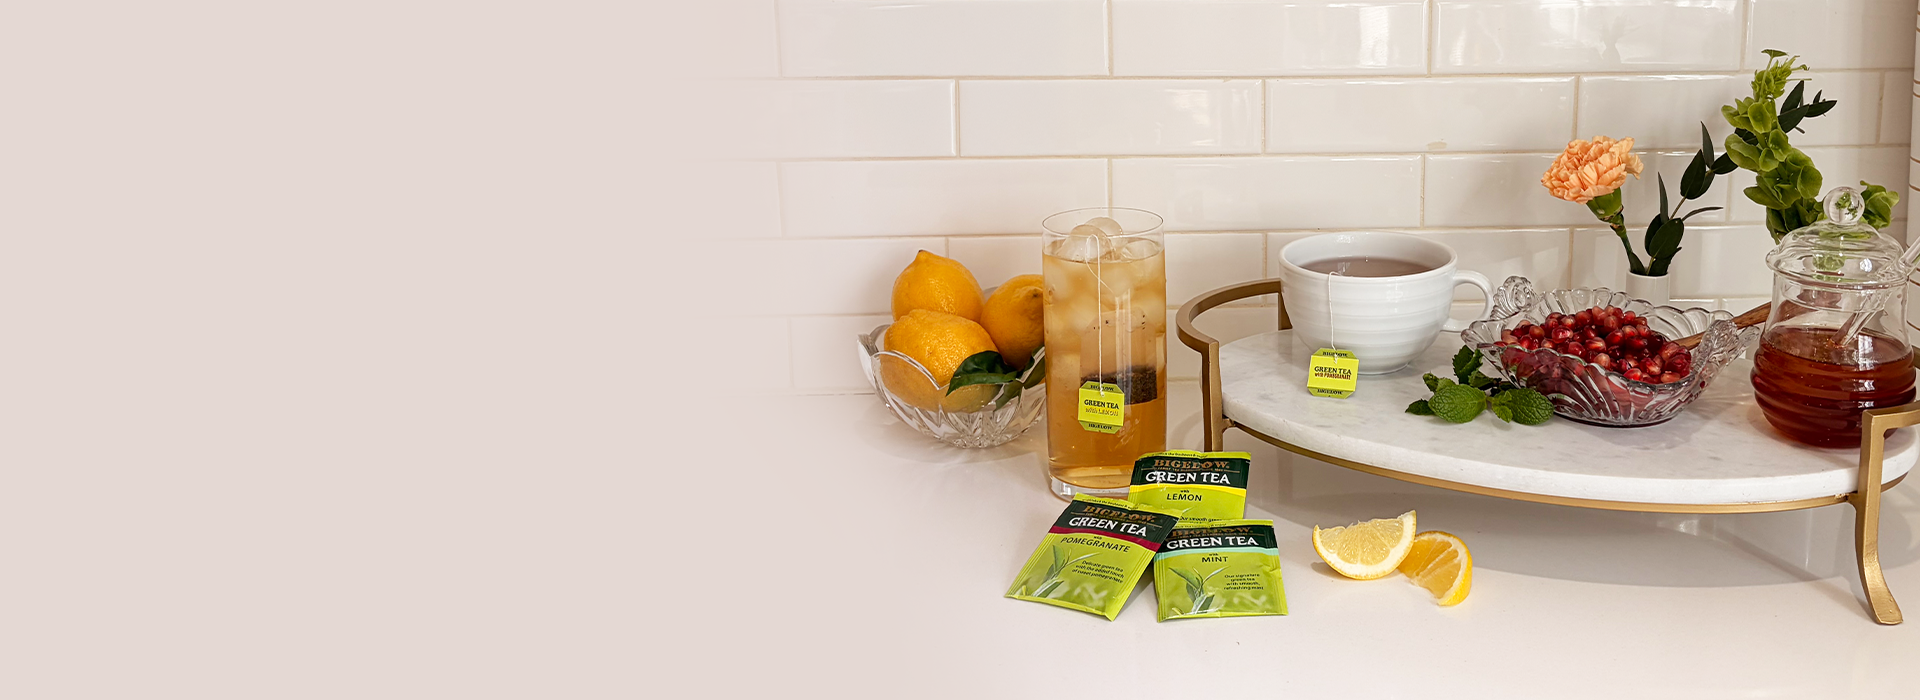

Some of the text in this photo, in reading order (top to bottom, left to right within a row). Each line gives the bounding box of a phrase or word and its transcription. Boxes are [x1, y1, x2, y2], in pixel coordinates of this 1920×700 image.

[1314, 365, 1352, 375] GREEN TEA
[1084, 399, 1119, 410] GREEN TEA
[1145, 470, 1231, 485] GREEN TEA
[1166, 493, 1202, 502] LEMON
[1068, 517, 1118, 530] GREEN
[1119, 522, 1147, 537] TEA
[1060, 536, 1131, 553] POMEGRANATE
[1166, 536, 1259, 550] GREEN TEA
